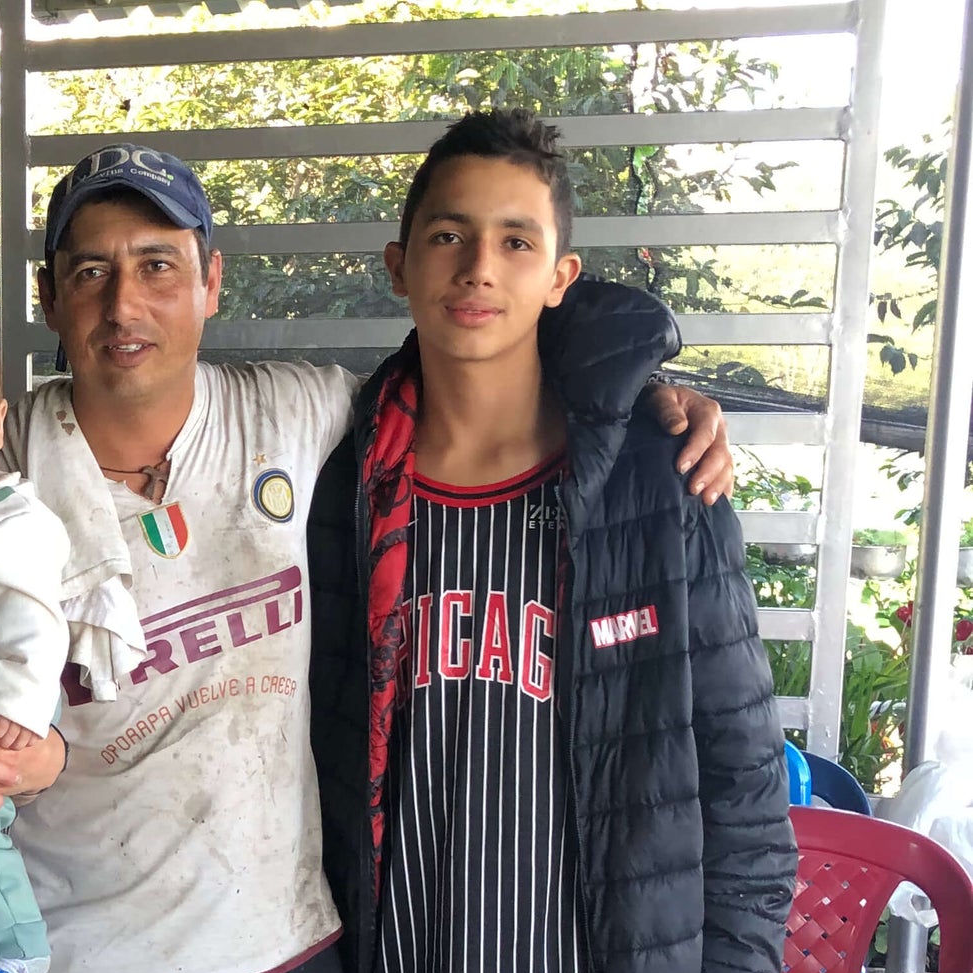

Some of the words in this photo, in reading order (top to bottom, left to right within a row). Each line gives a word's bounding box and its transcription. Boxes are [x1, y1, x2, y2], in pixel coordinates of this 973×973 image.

[130, 168, 171, 186] Company
[61, 565, 302, 706] PRELLI
[395, 589, 554, 702] HICAG
[591, 608, 657, 647] MARVEL
[101, 706, 174, 765] OPORAPA
[175, 679, 239, 714] VUELVE
[245, 676, 256, 695] A
[261, 675, 297, 698] CREER
